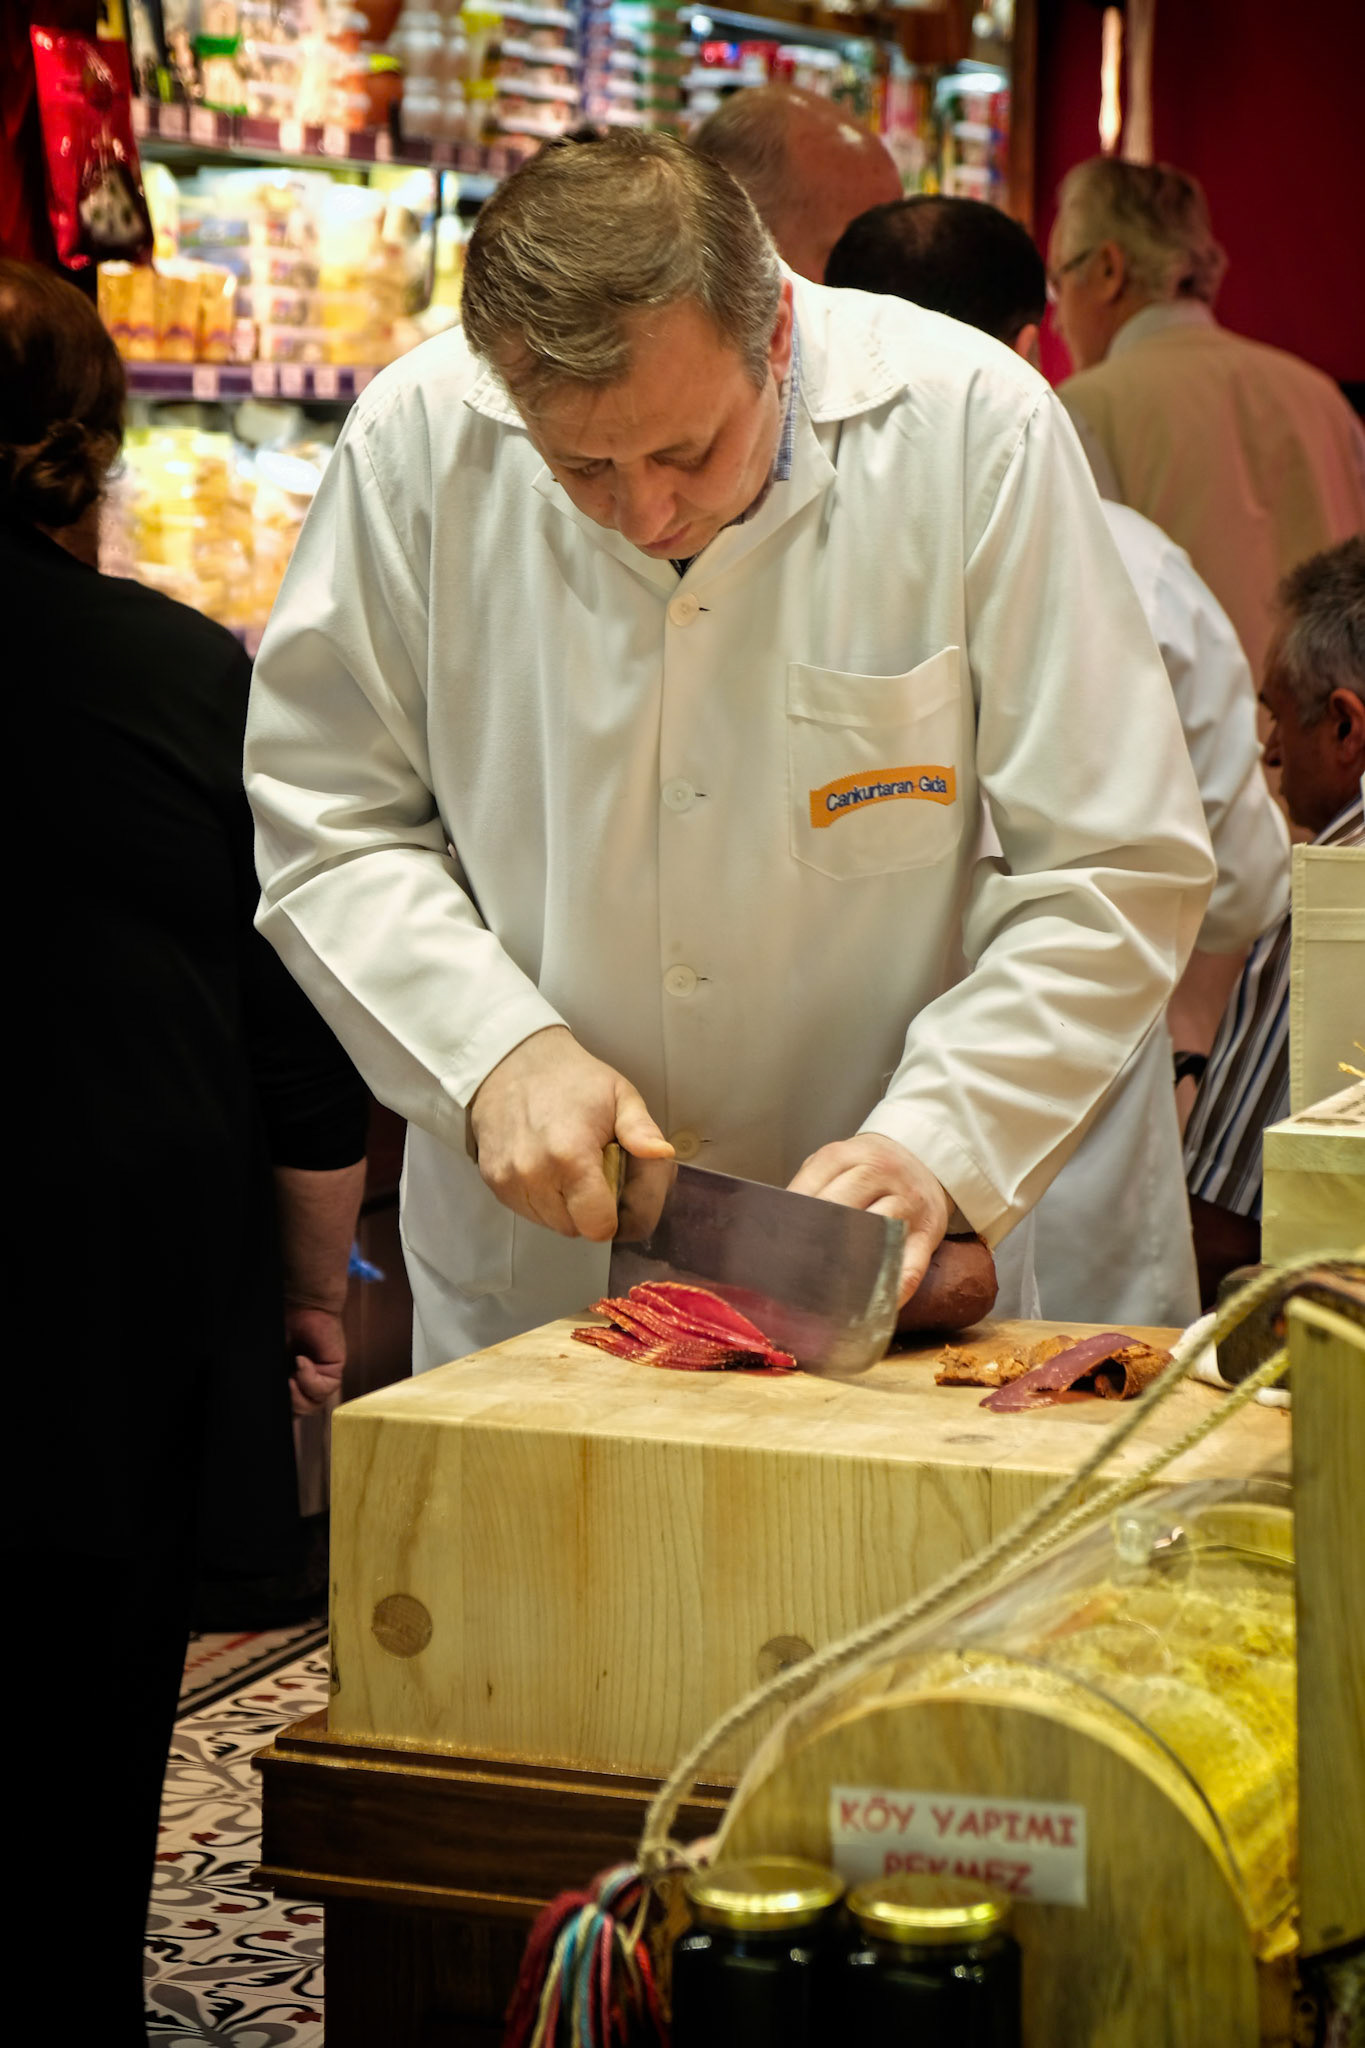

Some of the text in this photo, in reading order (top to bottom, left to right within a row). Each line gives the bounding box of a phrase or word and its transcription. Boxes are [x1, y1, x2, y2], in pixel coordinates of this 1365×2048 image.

[826, 781, 914, 811] Cankurtaran
[839, 1796, 1077, 1847] KÖY YAPIMI
